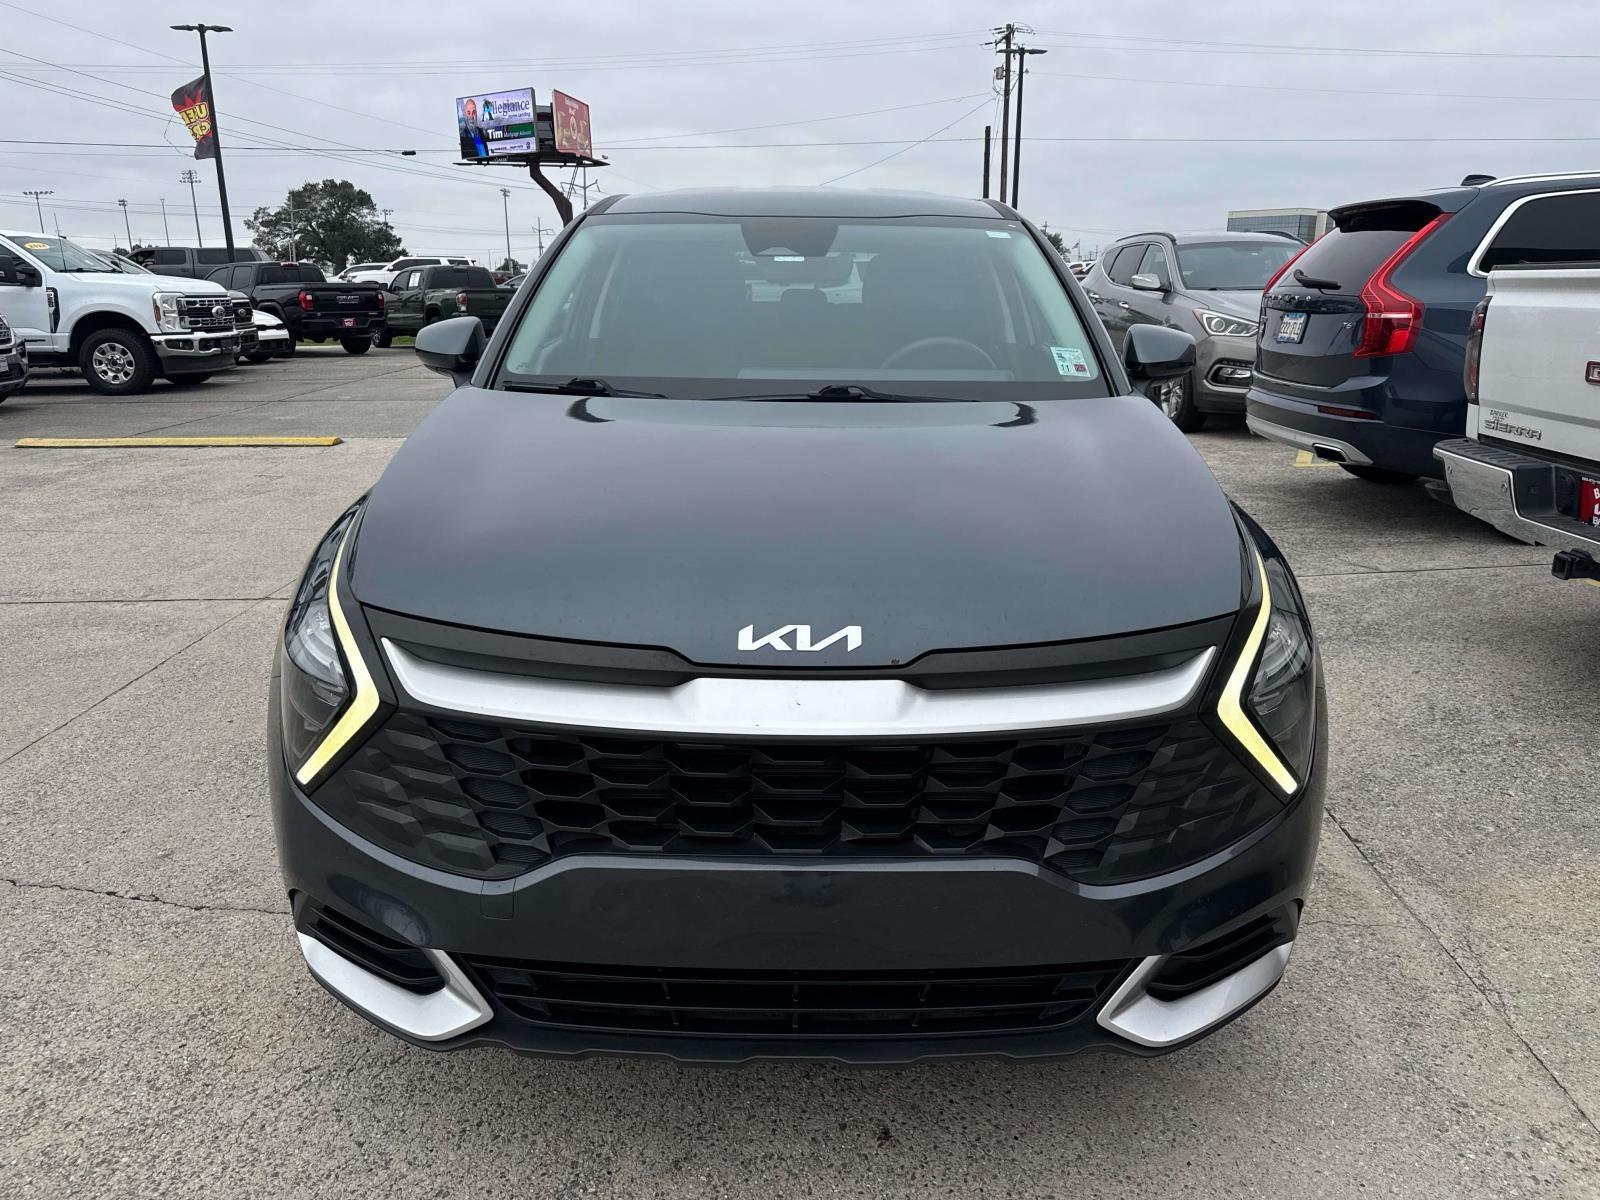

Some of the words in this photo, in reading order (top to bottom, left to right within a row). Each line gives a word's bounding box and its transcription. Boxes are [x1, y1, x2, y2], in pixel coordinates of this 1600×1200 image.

[487, 129, 503, 139] Tim
[1484, 419, 1542, 441] SIERRA
[737, 624, 863, 652] KIA
